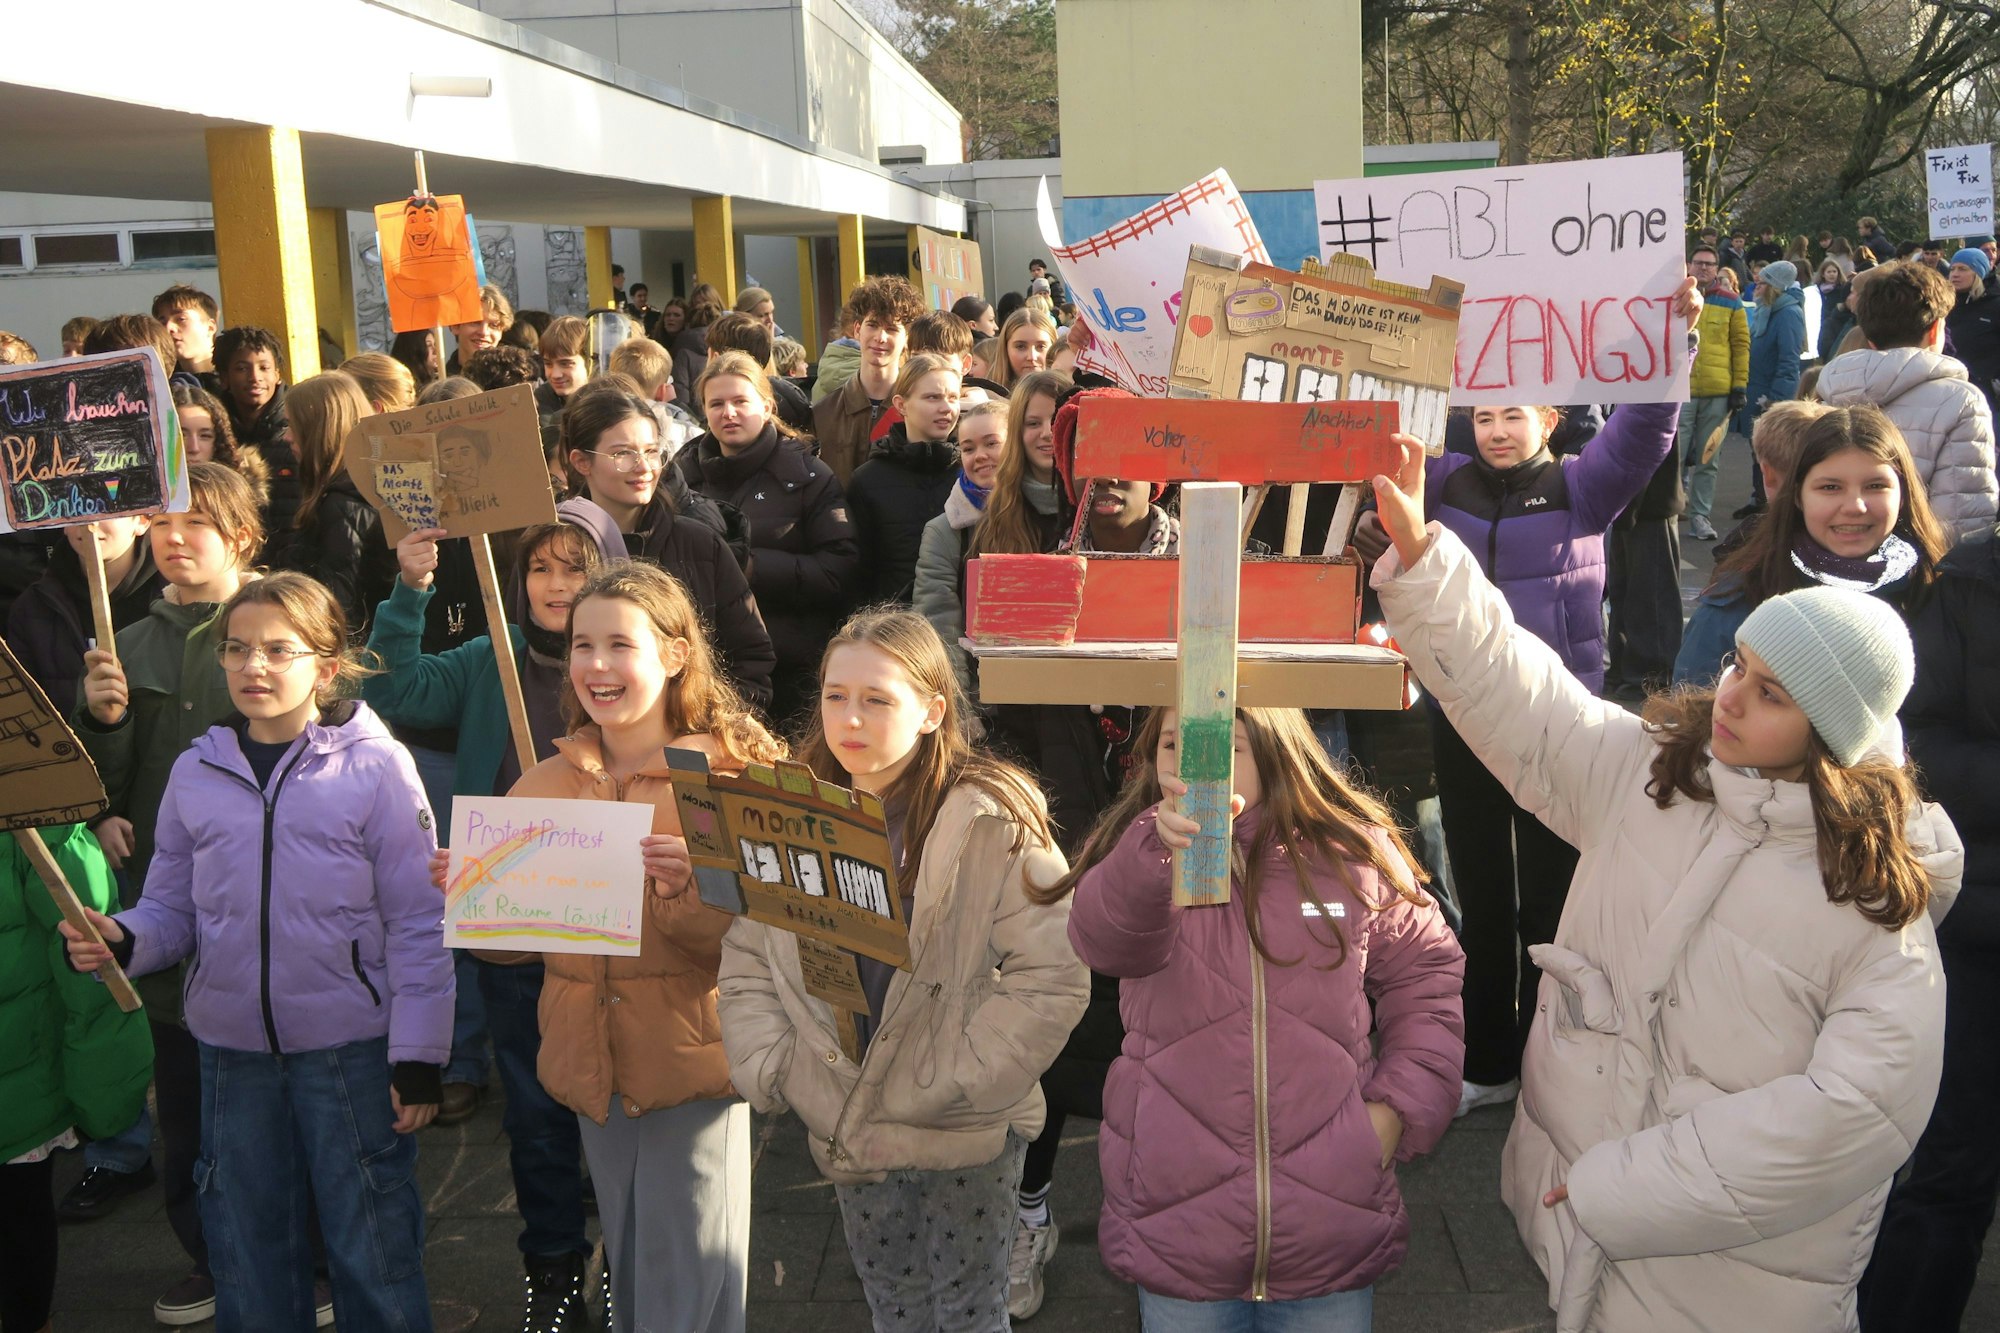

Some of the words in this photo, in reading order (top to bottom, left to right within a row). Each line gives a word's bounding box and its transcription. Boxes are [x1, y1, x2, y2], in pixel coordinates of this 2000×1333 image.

[1928, 155, 1953, 172] Fix
[1956, 154, 1970, 167] ist
[1957, 170, 1980, 184] Fix
[1321, 178, 1527, 270] #ABI
[1552, 182, 1667, 256] ohne
[1939, 212, 1988, 229] einhalten
[1293, 287, 1320, 306] DAS
[1327, 298, 1376, 316] MONTE
[1379, 309, 1395, 320] IST
[1453, 294, 1677, 390] ZANGST
[1, 387, 46, 426] Wir
[64, 381, 149, 423] brauchen
[389, 418, 413, 435] Die
[425, 409, 462, 426] Schule
[3, 435, 87, 484] Platz
[93, 452, 139, 472] zum
[383, 464, 404, 475] DAS
[18, 480, 108, 522] Denken
[1524, 496, 1547, 507] FILA
[467, 810, 534, 846] Protest
[538, 818, 605, 849] Protest
